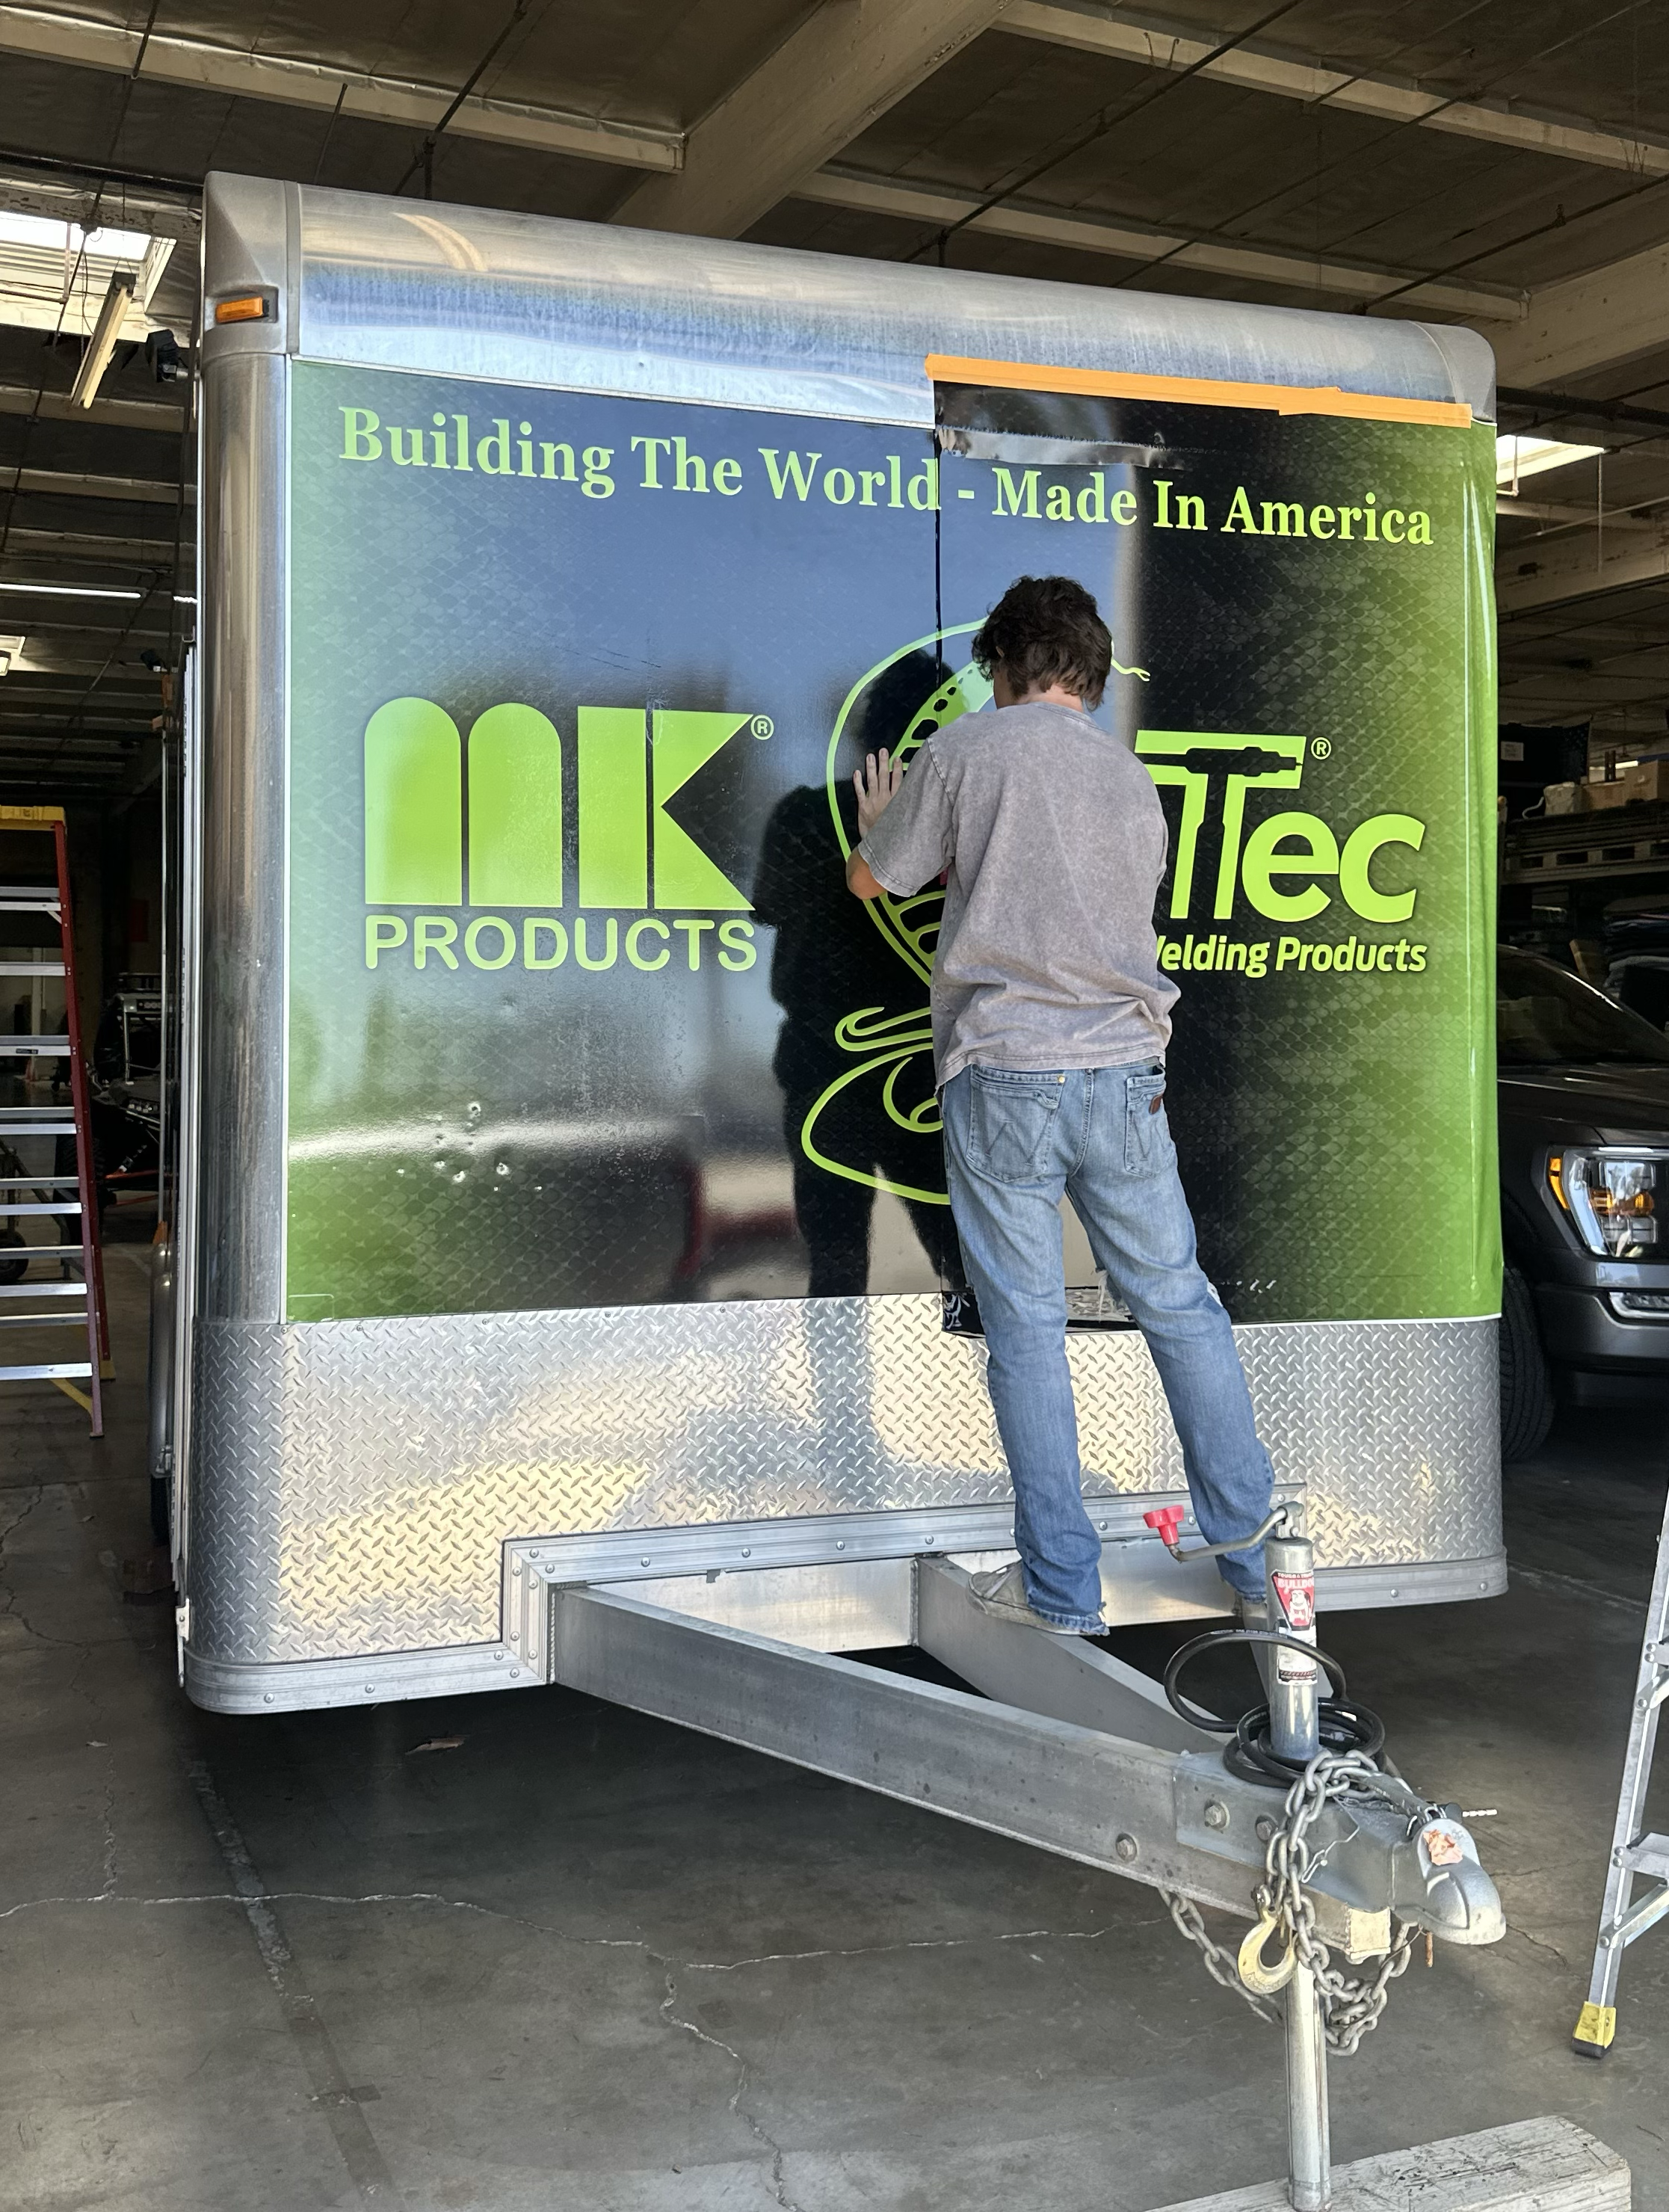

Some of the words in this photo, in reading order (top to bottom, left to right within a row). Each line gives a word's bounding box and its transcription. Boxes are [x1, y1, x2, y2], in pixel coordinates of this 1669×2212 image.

[339, 406, 615, 499] Building
[631, 436, 743, 496] The
[758, 448, 940, 511] World
[992, 466, 1137, 526] Made
[1153, 480, 1208, 531] In
[1221, 486, 1434, 546] America
[365, 914, 756, 971] PRODUCTS
[1275, 935, 1428, 972] Products
